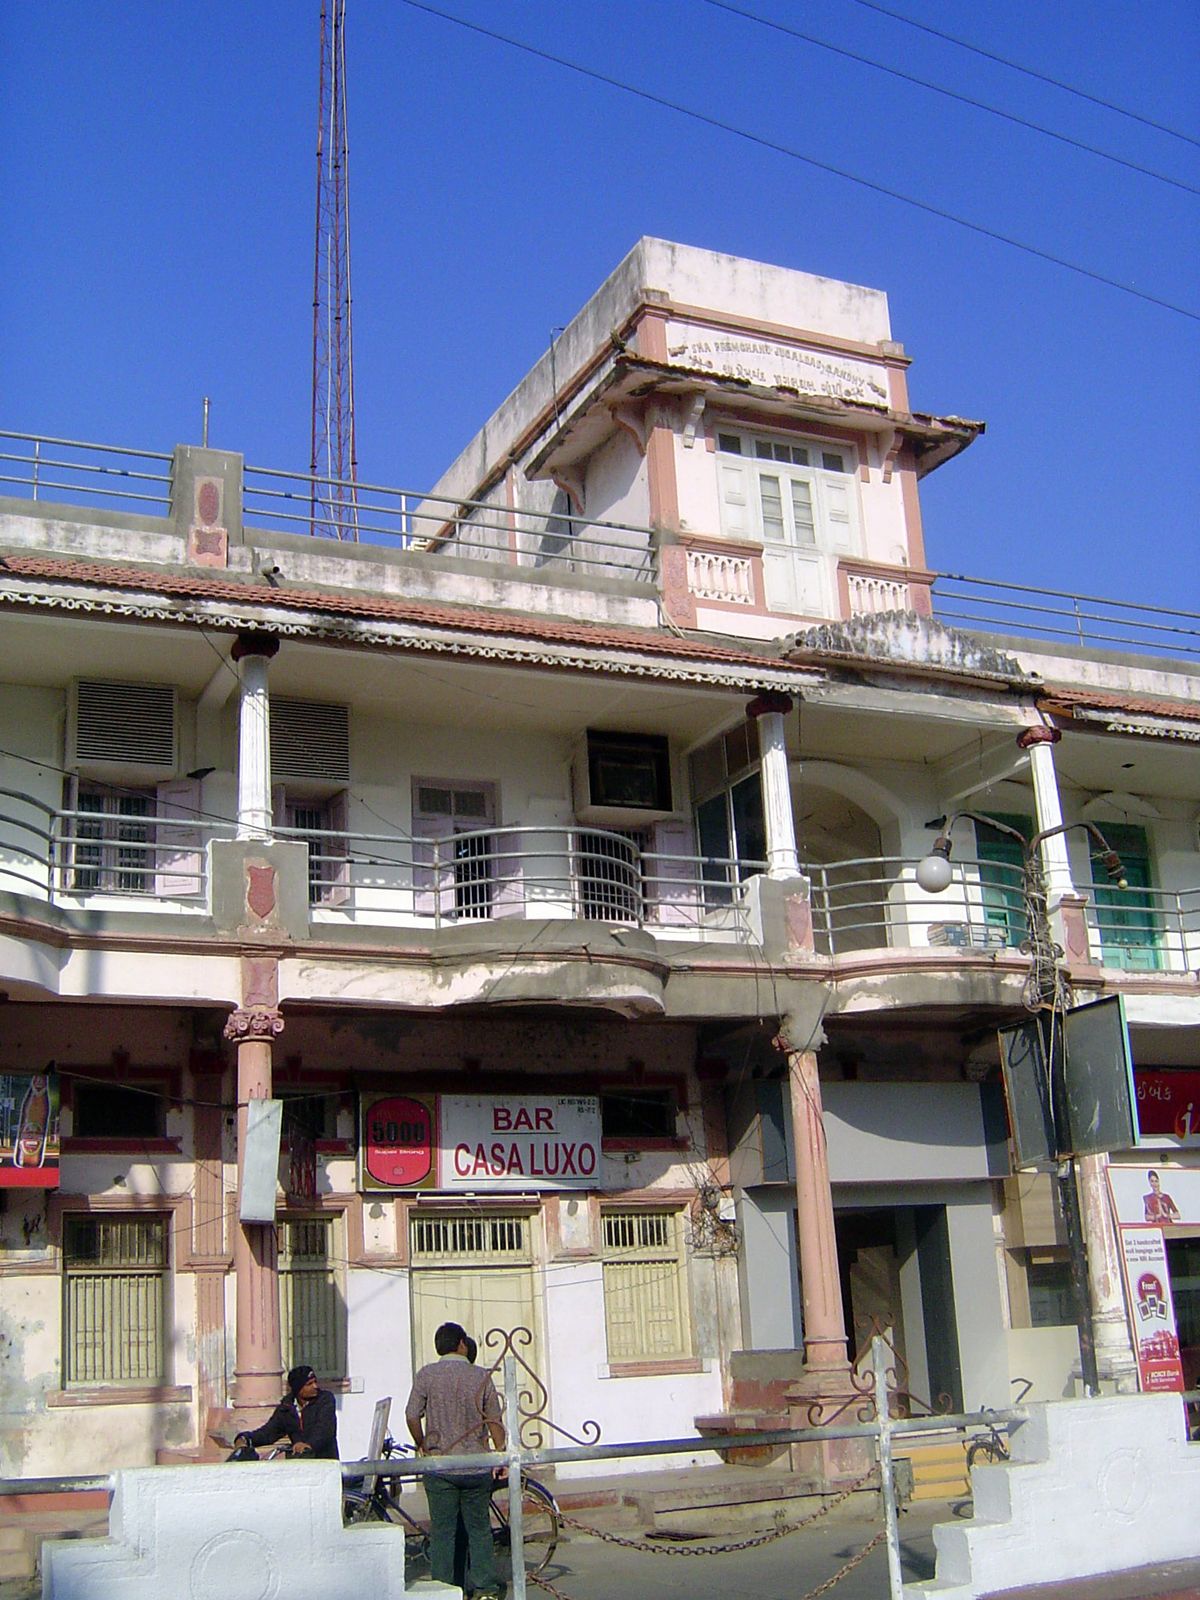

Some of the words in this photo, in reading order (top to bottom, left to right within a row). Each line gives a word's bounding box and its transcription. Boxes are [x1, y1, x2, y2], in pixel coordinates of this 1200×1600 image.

[493, 1107, 554, 1131] BAR
[371, 1120, 426, 1143] 5000
[374, 1148, 398, 1156] Super
[399, 1148, 425, 1156] Strong
[454, 1142, 525, 1176] CASA
[529, 1142, 597, 1176] LUXO
